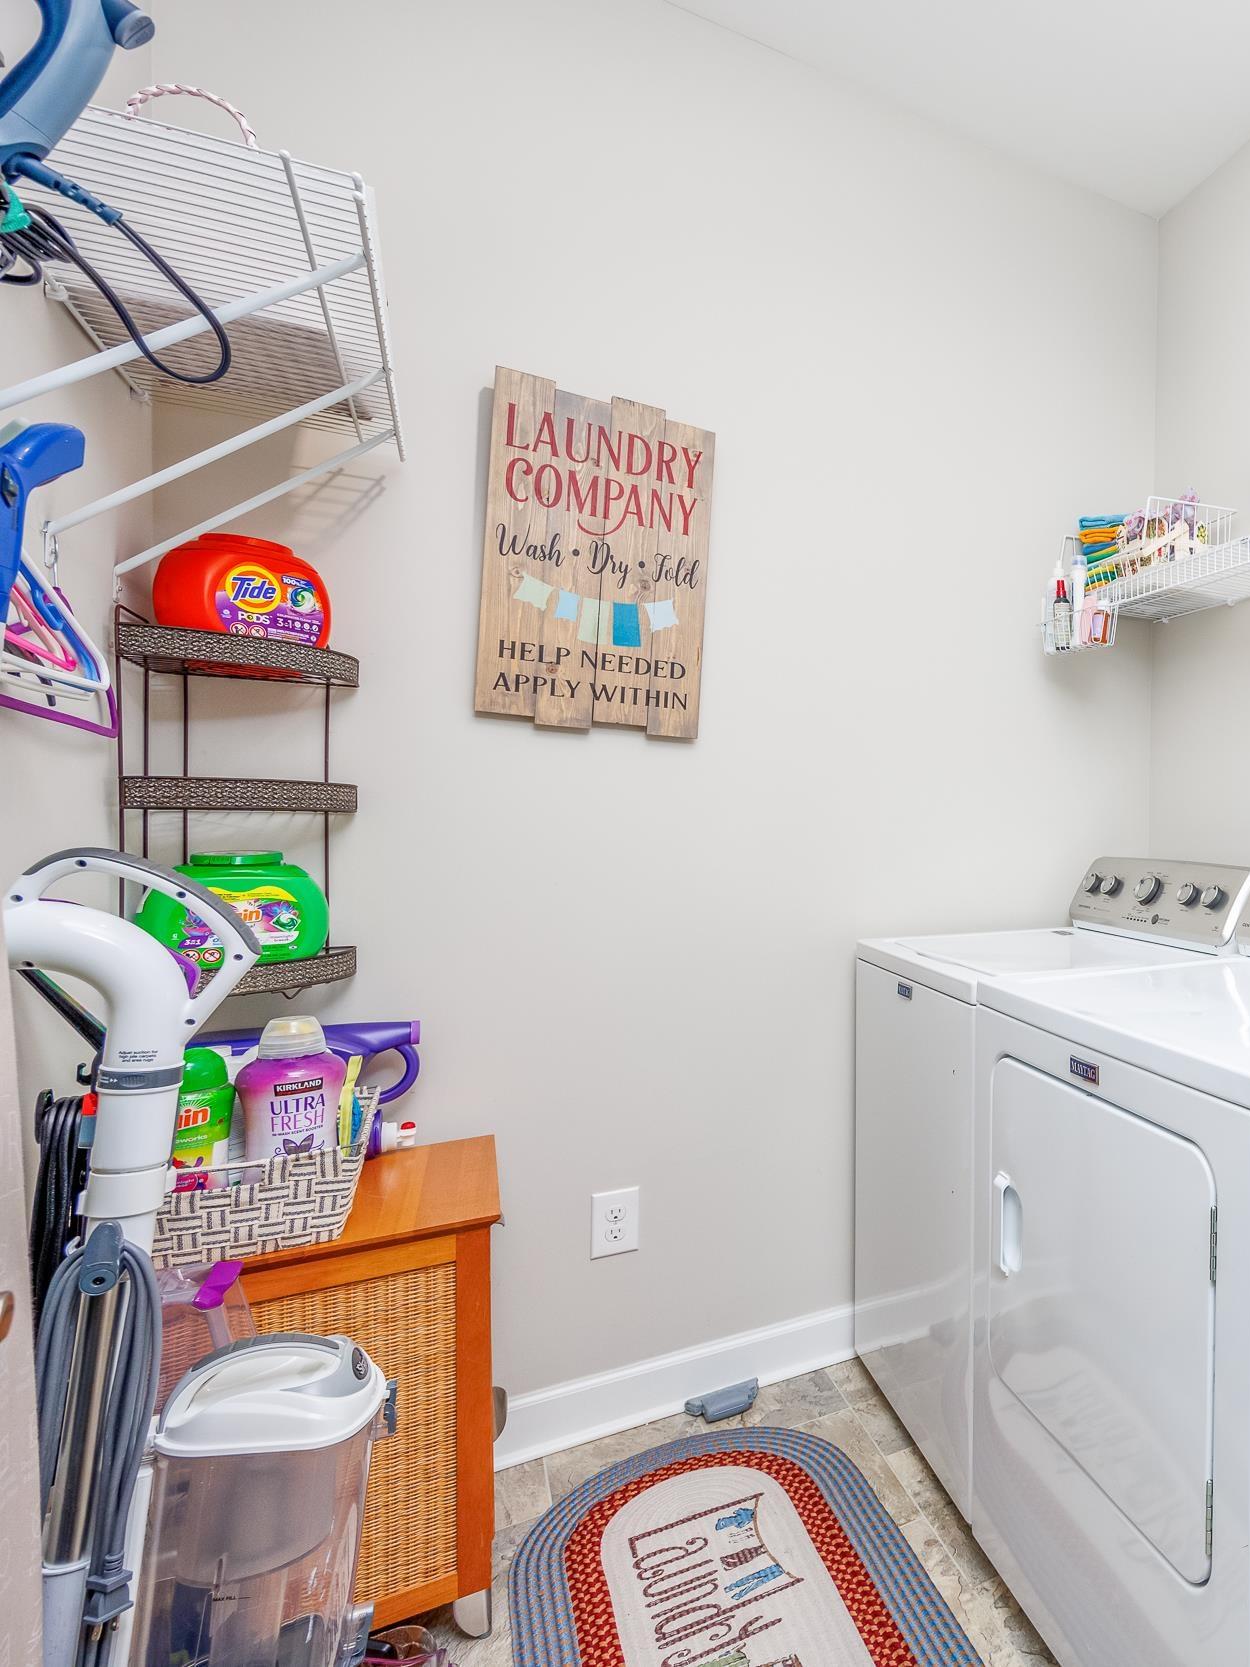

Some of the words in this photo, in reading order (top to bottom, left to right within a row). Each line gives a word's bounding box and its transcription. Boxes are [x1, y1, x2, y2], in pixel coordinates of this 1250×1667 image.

[505, 403, 702, 489] LAUNDRY
[505, 457, 697, 536] COMPANY
[496, 524, 564, 567] Wash
[587, 541, 631, 588] Dry
[652, 553, 701, 589] Fold
[230, 576, 277, 602] Tide
[238, 611, 270, 625] PODS
[499, 639, 571, 666] HELP
[581, 650, 686, 680] NEEDED
[493, 672, 581, 699] APPLY
[590, 683, 687, 710] WITHIN
[236, 909, 262, 922] in
[1072, 1061, 1095, 1079] MAYTAG
[276, 1079, 322, 1092] KIRKLAND
[270, 1093, 325, 1115] ULTRA
[271, 1108, 324, 1132] FRESH
[306, 1124, 323, 1132] BOOSTER
